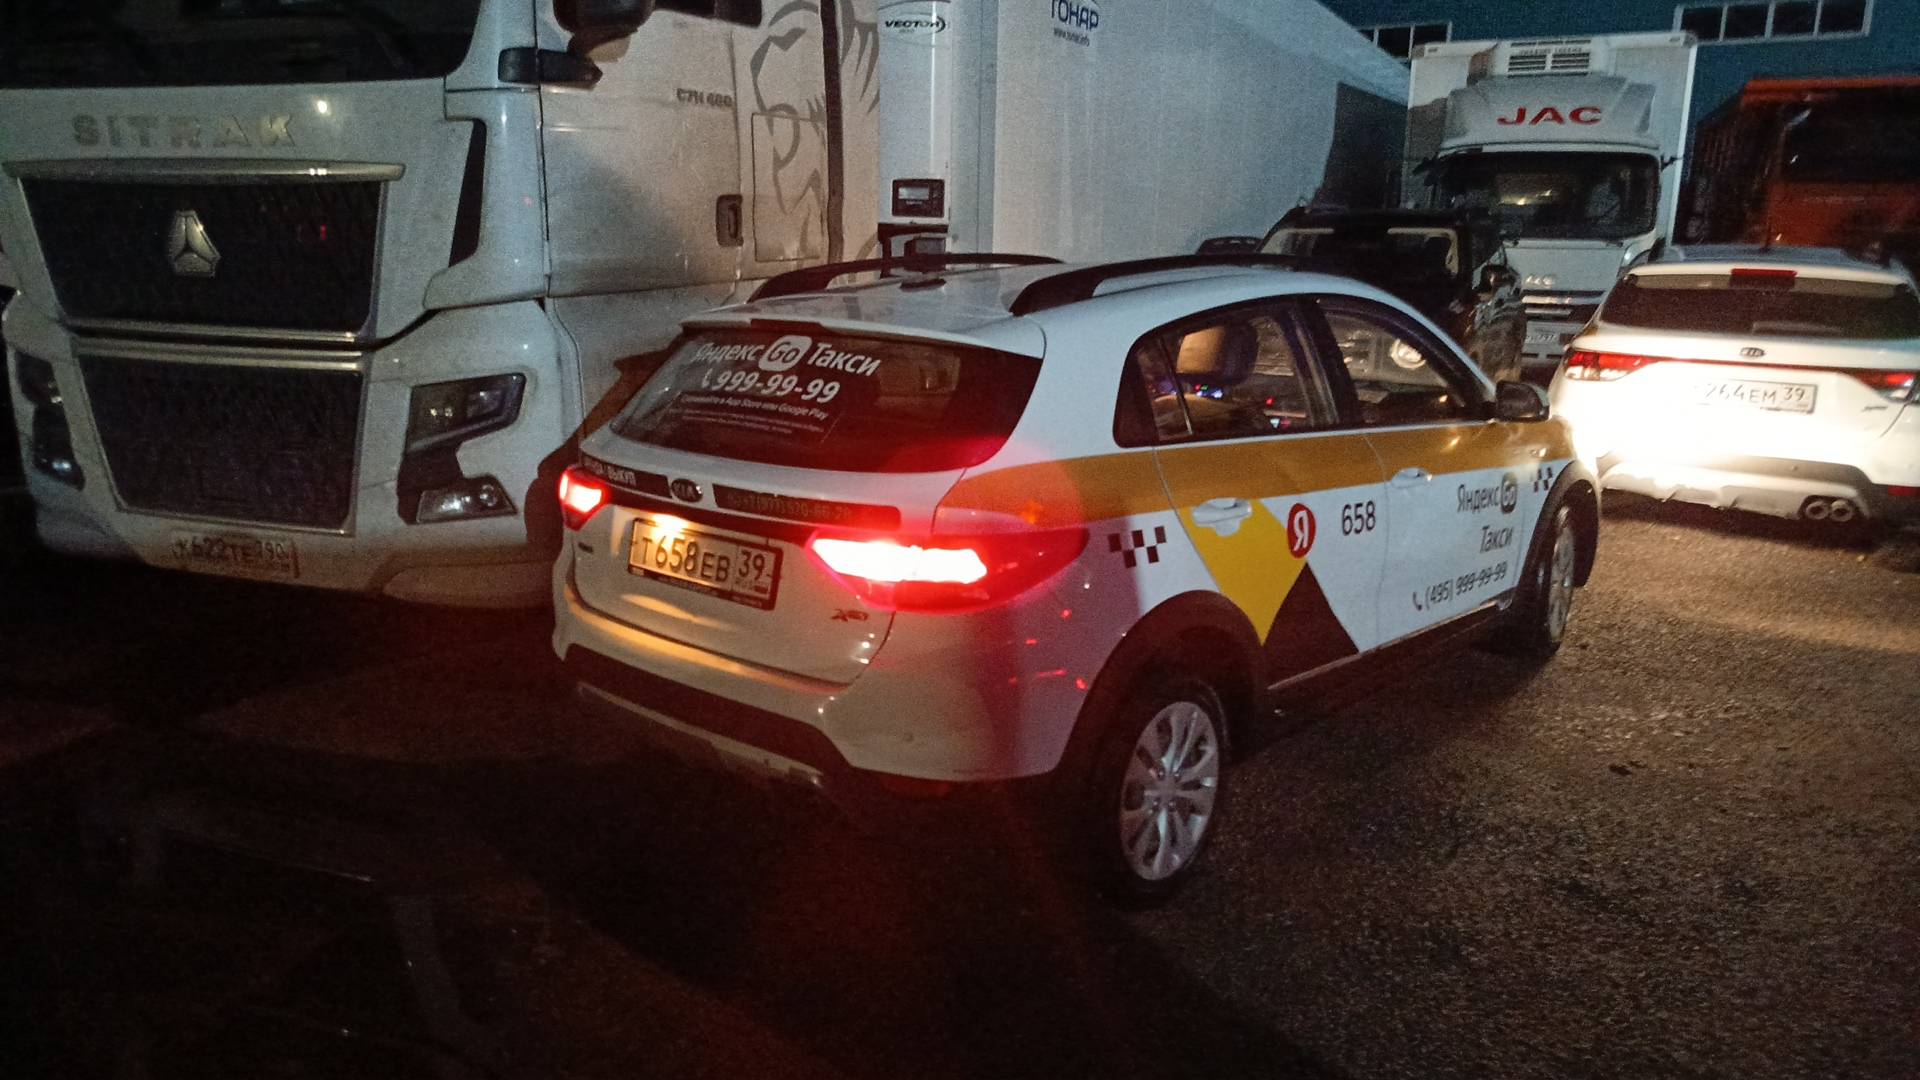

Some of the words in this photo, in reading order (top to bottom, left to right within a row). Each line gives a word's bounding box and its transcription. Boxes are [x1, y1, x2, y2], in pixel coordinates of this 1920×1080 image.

[72, 113, 296, 148] SITRAK
[1497, 106, 1602, 125] JAC
[691, 341, 765, 366] Яндекс
[808, 343, 881, 376] Такси
[711, 370, 841, 404] 999-99-99
[1783, 386, 1806, 401] 39
[778, 402, 808, 417] Google
[808, 407, 830, 422] Play
[1457, 483, 1499, 515] Яндекс
[1292, 510, 1310, 552] Я
[1341, 500, 1377, 537] 658
[1479, 524, 1514, 555] Такси
[642, 534, 731, 583] Т658ЕВ
[738, 550, 766, 582] 39
[1425, 579, 1454, 610] (495)
[1455, 561, 1508, 596] 999-99-99
